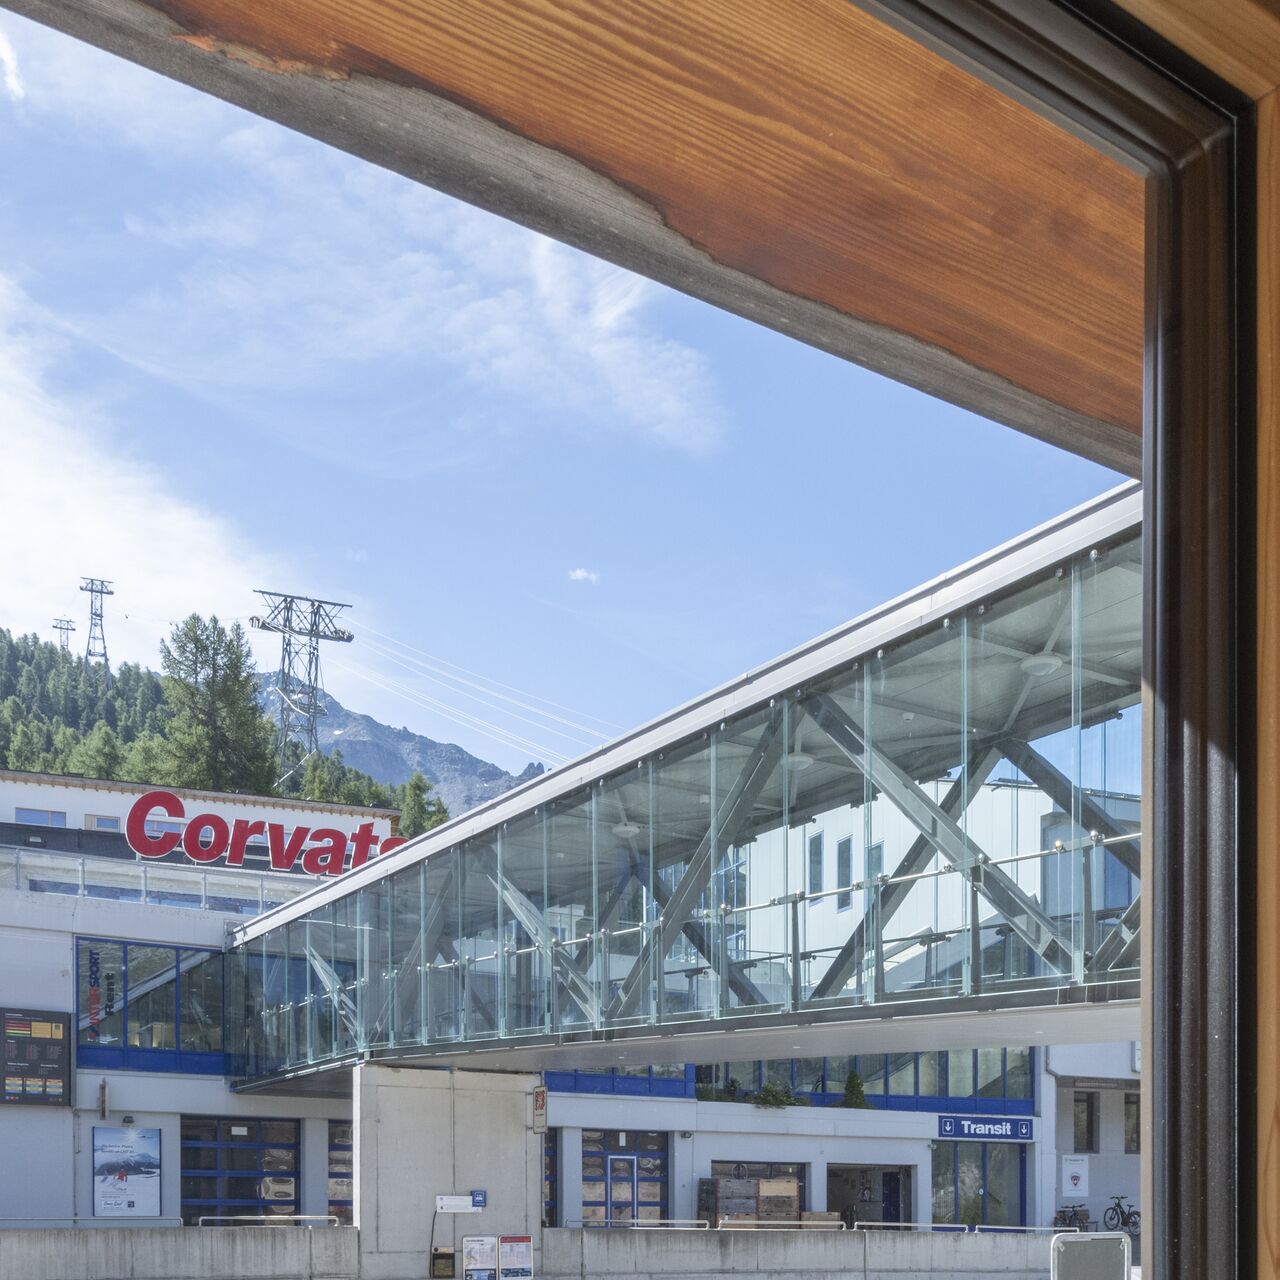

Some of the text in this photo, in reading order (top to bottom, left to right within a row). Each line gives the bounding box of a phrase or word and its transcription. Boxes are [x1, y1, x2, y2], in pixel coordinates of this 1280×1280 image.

[88, 949, 100, 1025] INTERSPORT
[104, 972, 114, 1016] Rent
[961, 1120, 1011, 1135] Transit
